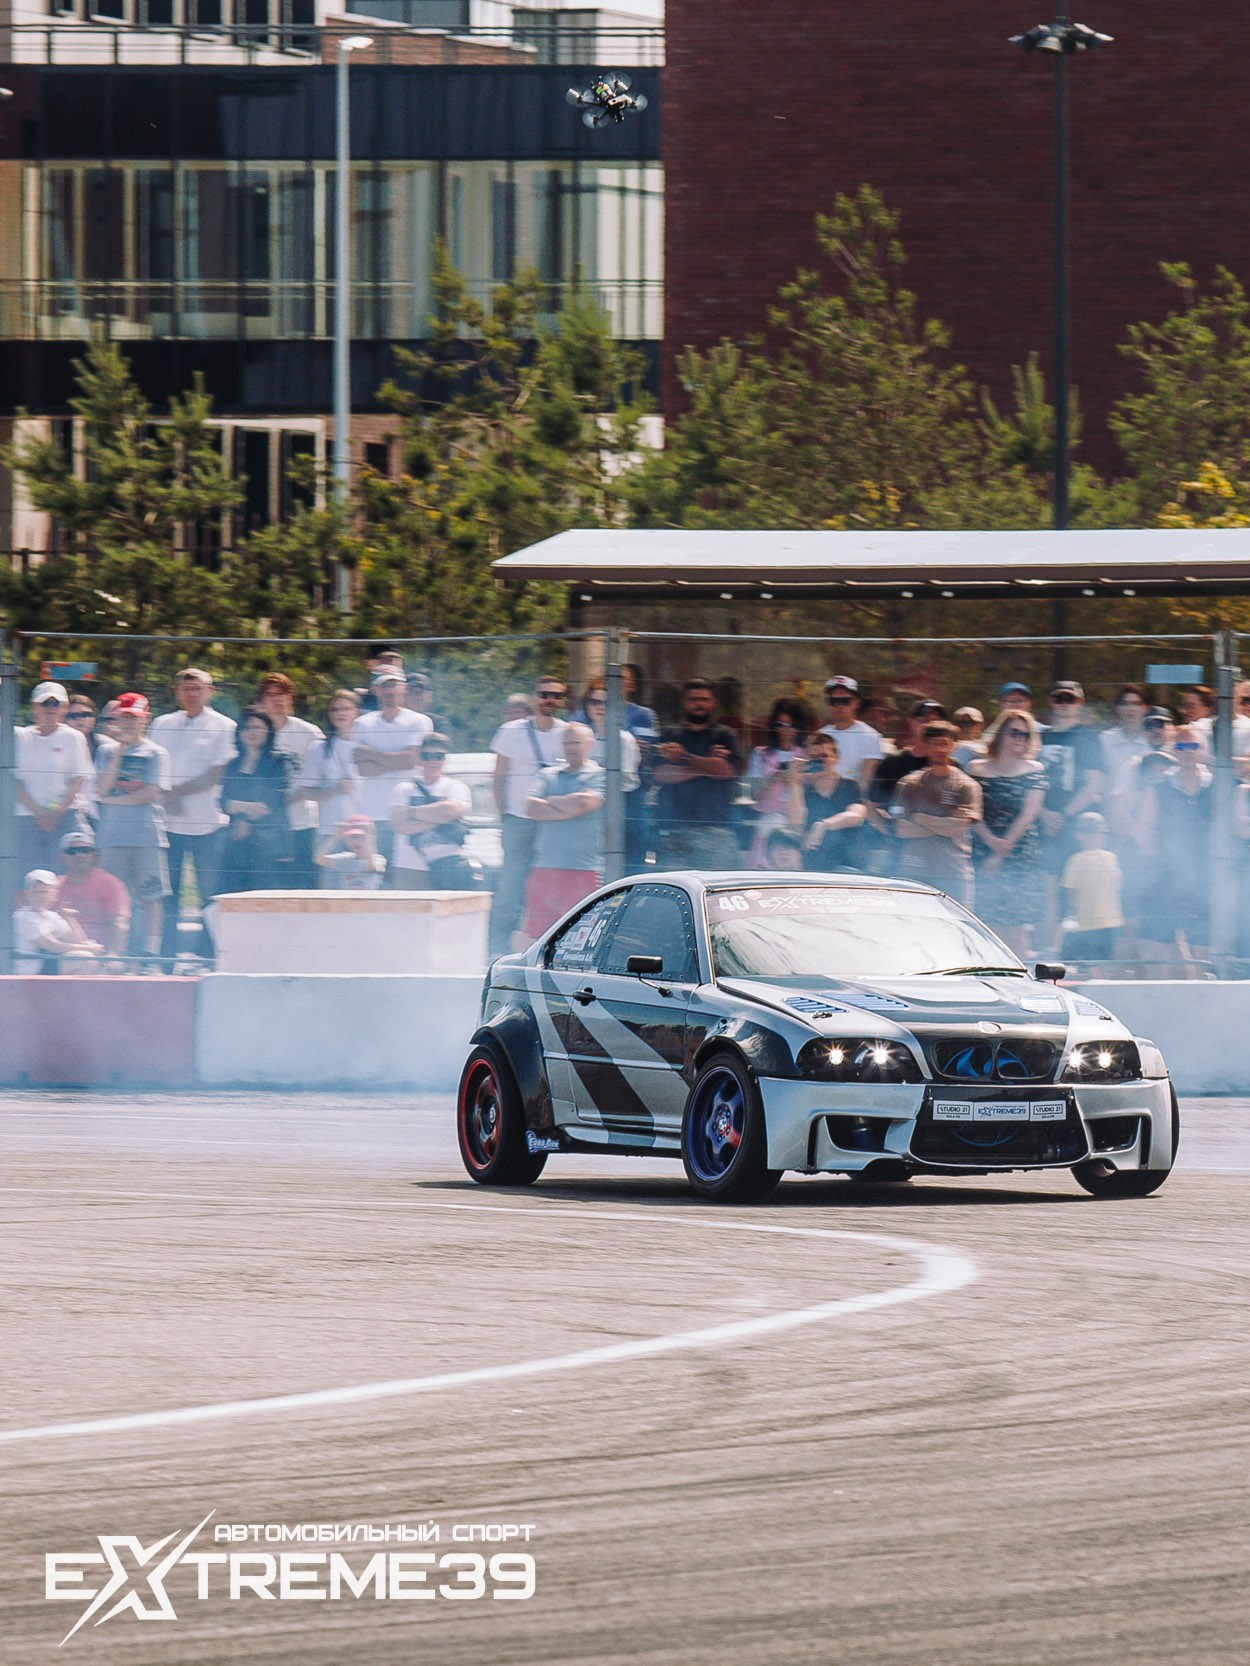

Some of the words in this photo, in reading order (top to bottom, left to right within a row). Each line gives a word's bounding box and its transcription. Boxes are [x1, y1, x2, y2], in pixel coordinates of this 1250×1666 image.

[718, 895, 749, 912] 46
[587, 919, 607, 948] 46
[977, 1105, 1027, 1118] EXTREME39
